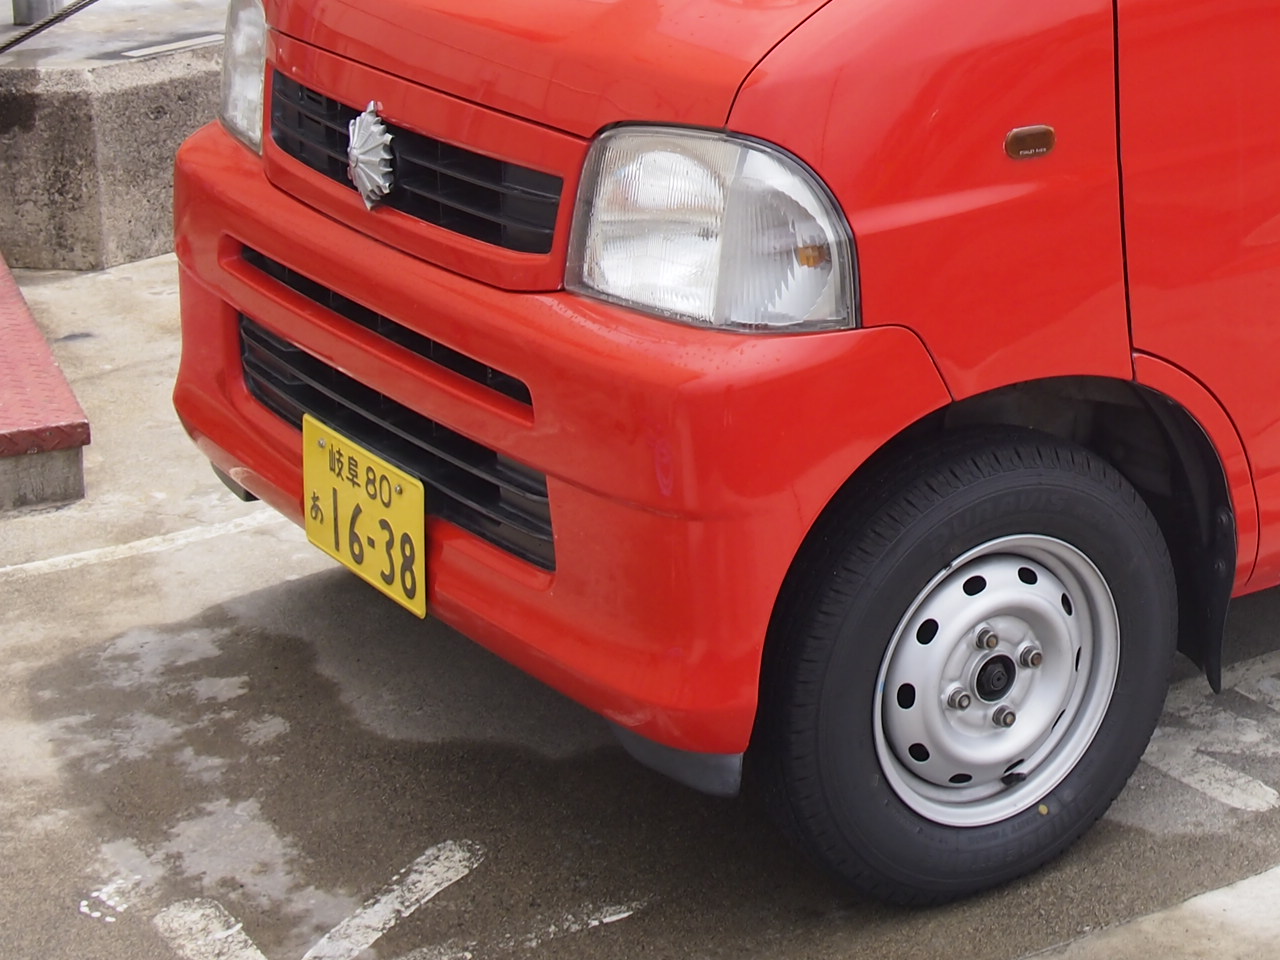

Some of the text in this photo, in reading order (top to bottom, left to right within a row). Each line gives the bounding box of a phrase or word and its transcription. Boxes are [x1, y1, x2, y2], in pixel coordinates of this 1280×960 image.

[310, 491, 324, 525] あ
[329, 444, 392, 509] 岐阜 80
[332, 487, 416, 600] 16-38
